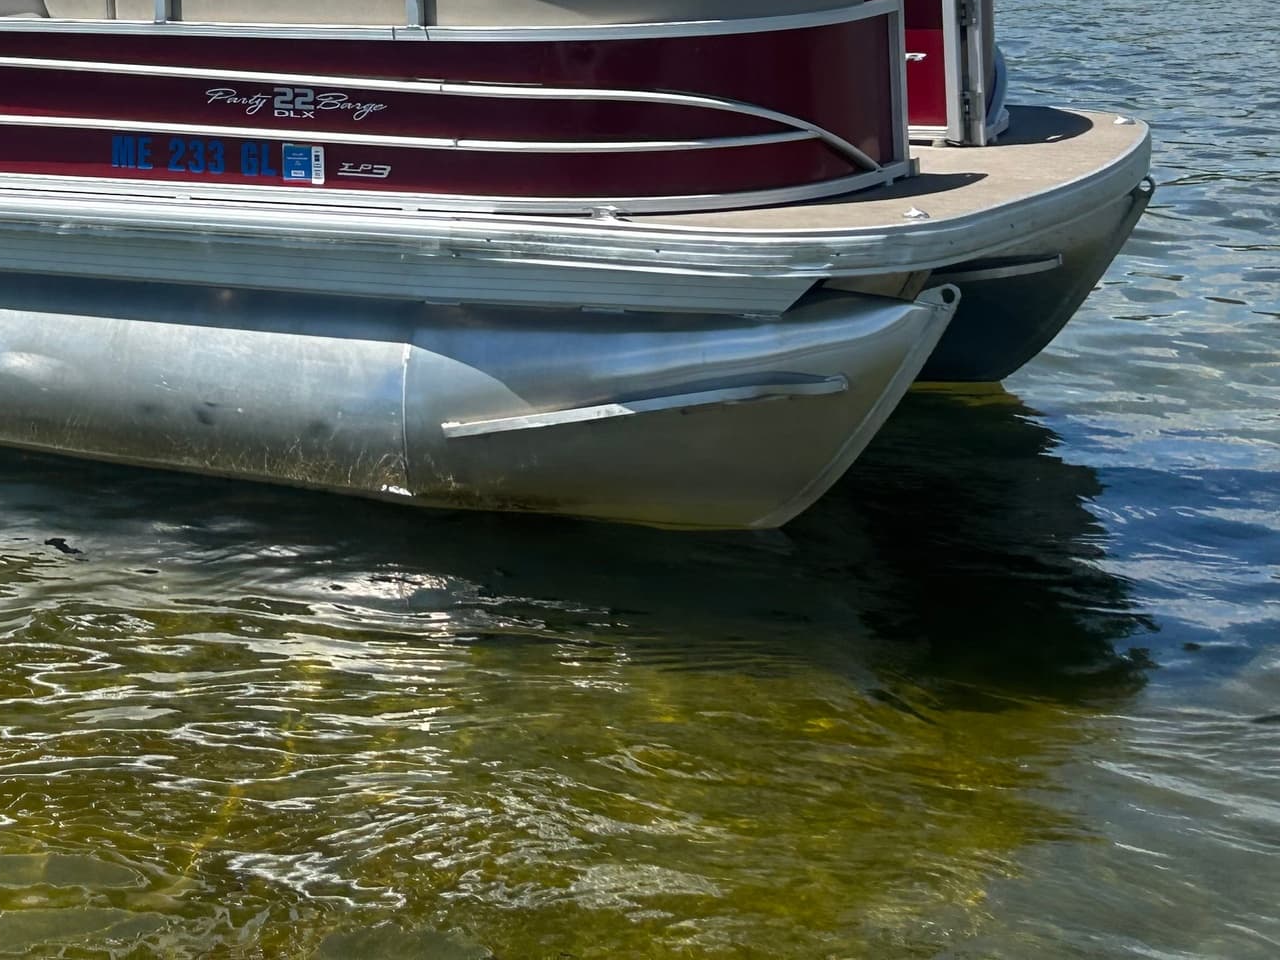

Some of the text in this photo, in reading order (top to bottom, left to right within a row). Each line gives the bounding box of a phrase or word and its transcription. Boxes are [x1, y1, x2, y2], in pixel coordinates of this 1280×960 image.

[206, 87, 388, 121] Party 22 Barge
[273, 110, 315, 119] DLX
[111, 135, 154, 170] ME
[167, 140, 226, 175] 233
[240, 142, 278, 177] GL
